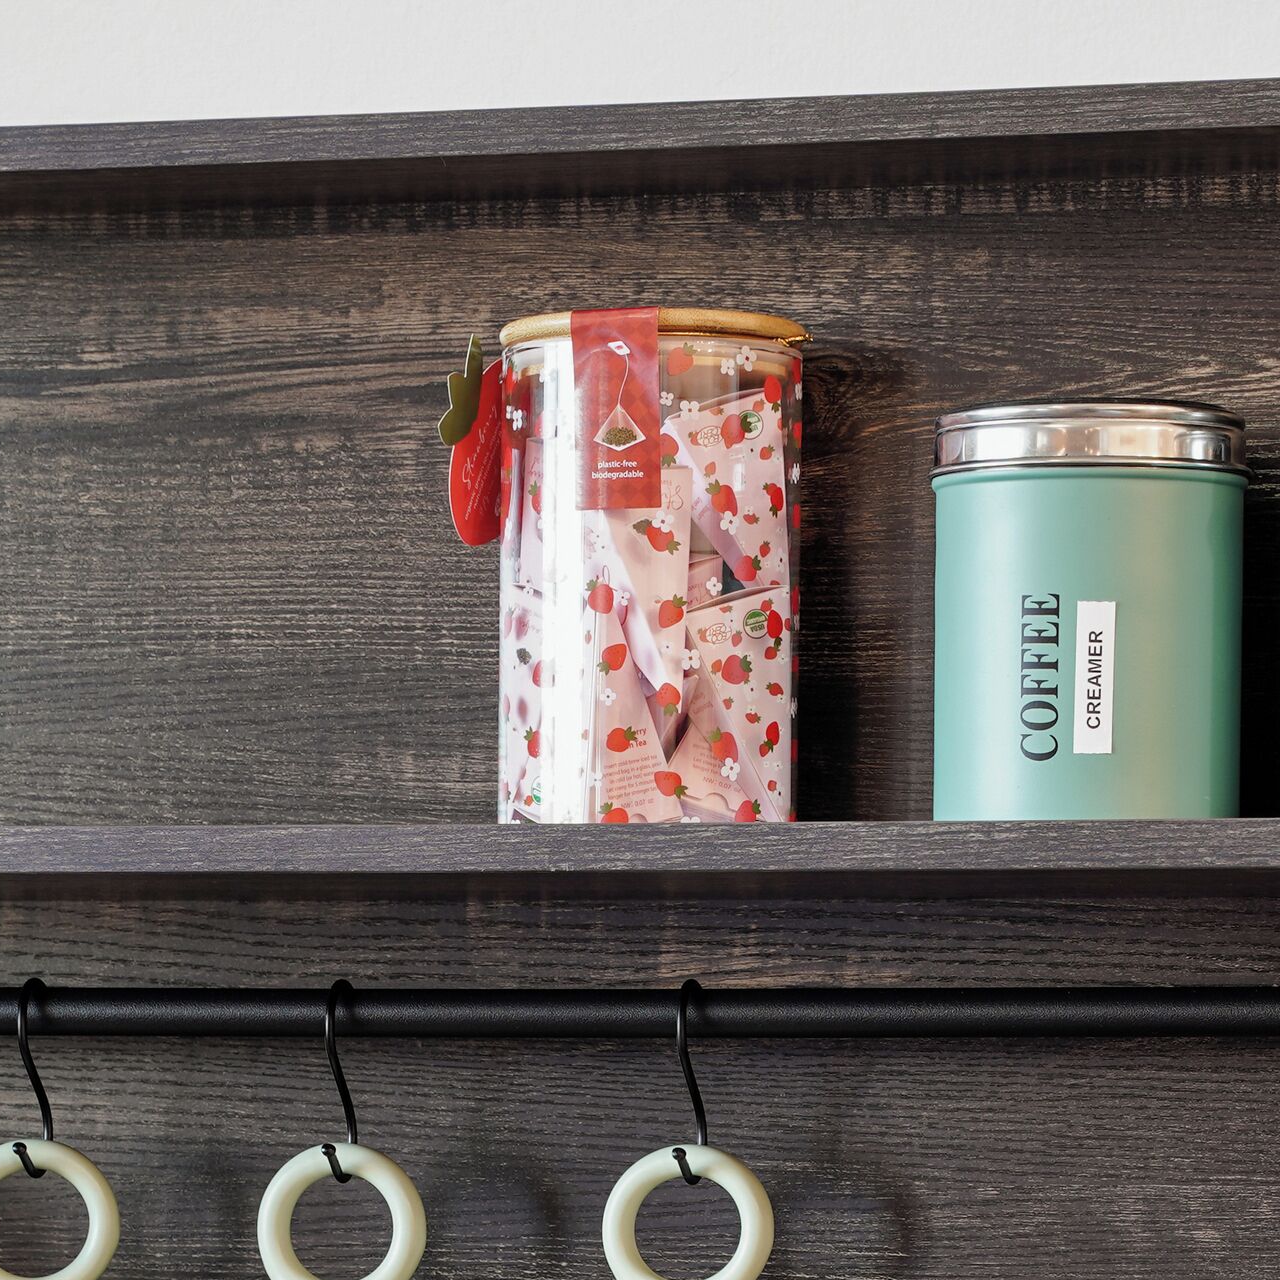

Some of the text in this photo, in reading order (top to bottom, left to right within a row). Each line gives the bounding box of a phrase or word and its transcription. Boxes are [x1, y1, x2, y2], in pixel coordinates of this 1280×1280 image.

[591, 470, 644, 479] biodegradable
[597, 460, 638, 469] plastic-free
[1021, 594, 1059, 761] COFFEE
[1087, 632, 1102, 729] CREAMER
